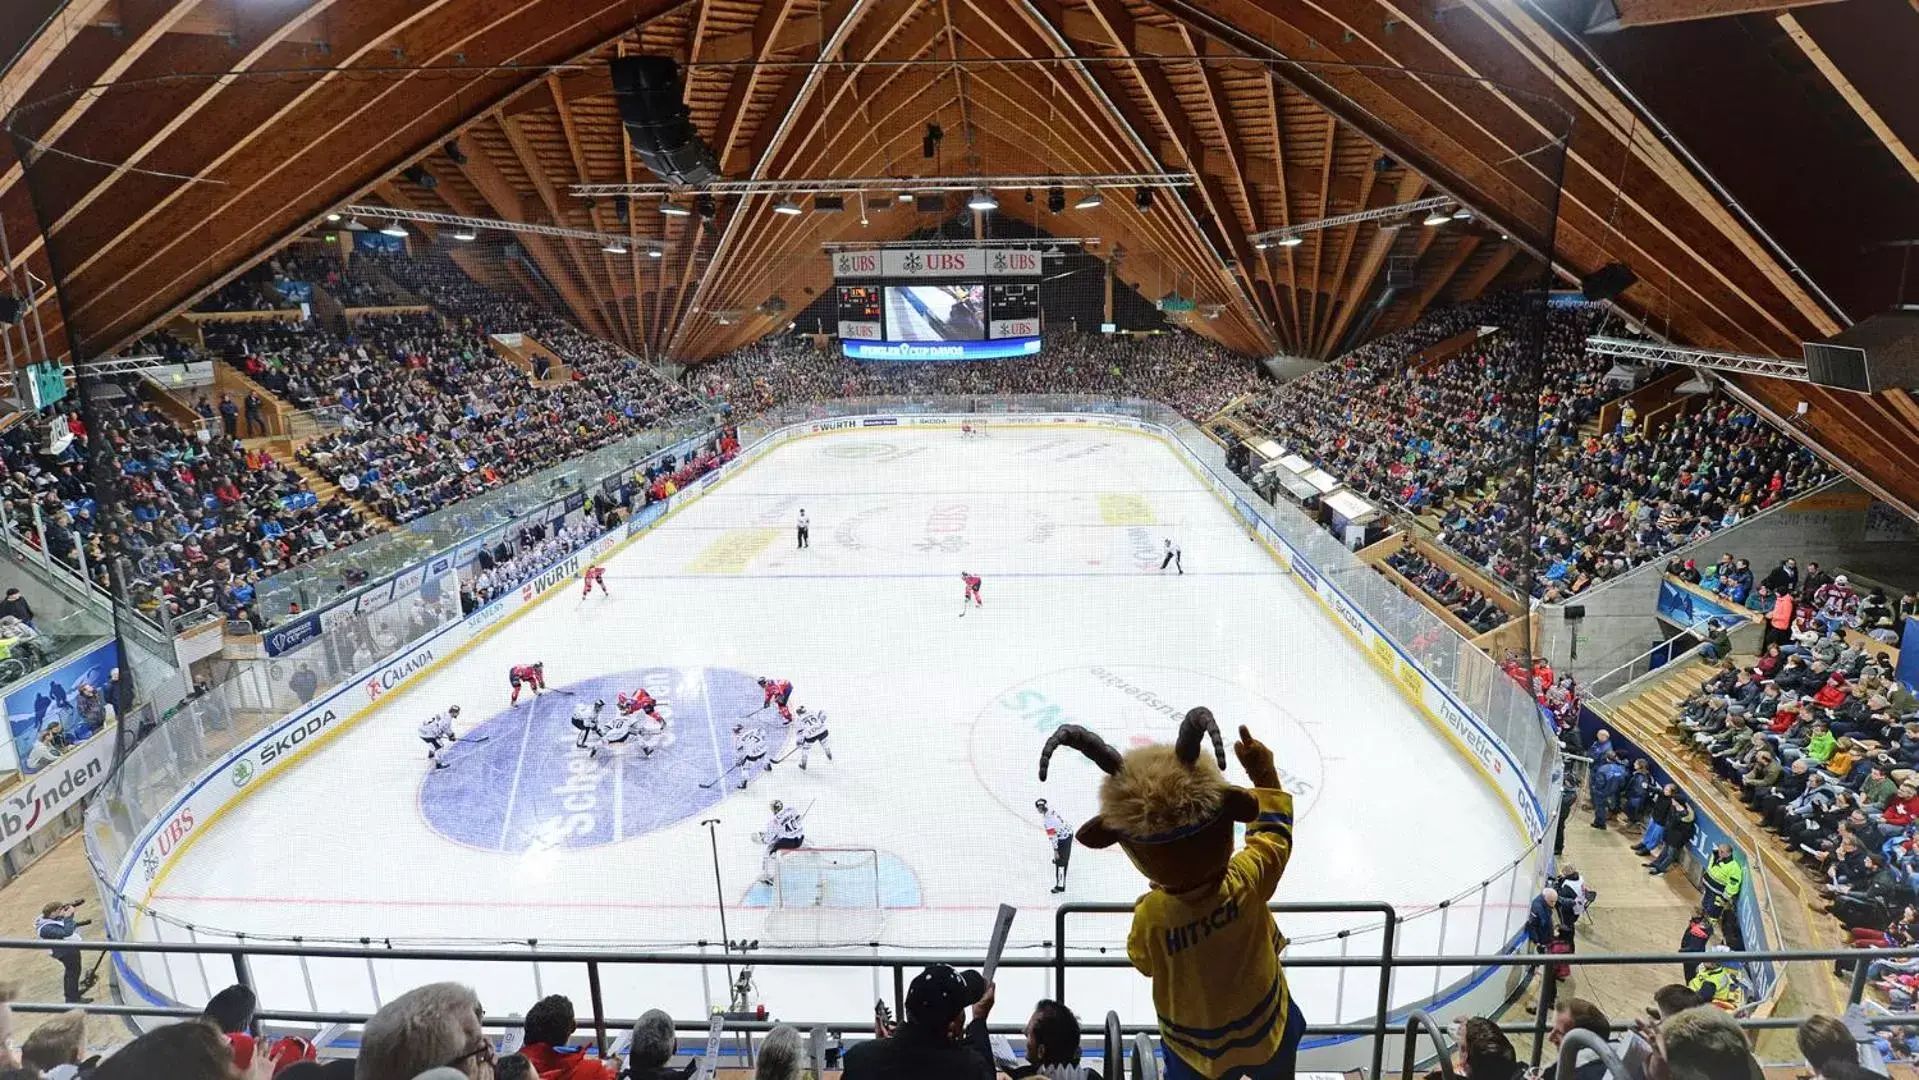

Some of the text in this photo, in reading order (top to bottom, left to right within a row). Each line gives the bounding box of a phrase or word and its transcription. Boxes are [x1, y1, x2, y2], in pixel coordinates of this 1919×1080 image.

[852, 255, 875, 272] UBS
[926, 254, 965, 270] UBS
[1009, 254, 1036, 270] UBS
[856, 325, 873, 337] UBS
[1011, 323, 1032, 335] UBS
[820, 420, 856, 432] WÜRTH
[534, 557, 580, 594] WÜRTH
[1335, 599, 1364, 636] ŠKODA
[382, 649, 434, 690] CALANDA
[260, 709, 337, 766] ŠKODA
[1440, 700, 1493, 763] helvetic
[156, 808, 195, 857] UBS
[1165, 897, 1239, 956] HITSCH
